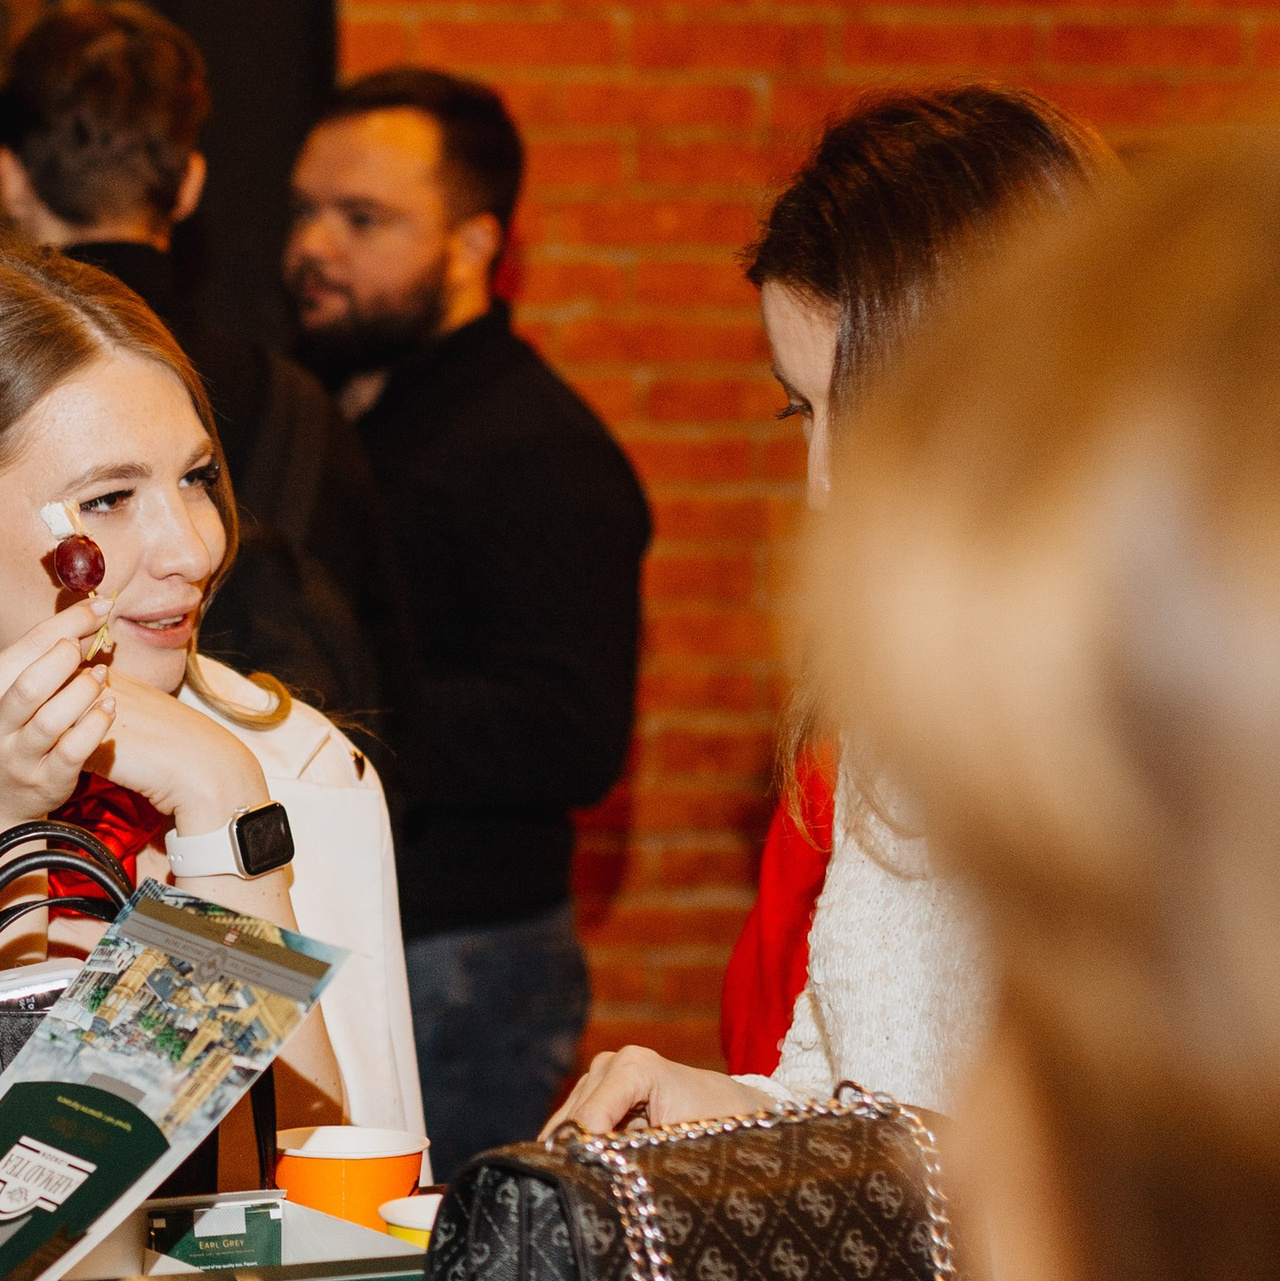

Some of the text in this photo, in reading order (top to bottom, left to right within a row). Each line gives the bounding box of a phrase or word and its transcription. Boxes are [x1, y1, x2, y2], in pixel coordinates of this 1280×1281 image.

[1, 1153, 79, 1197] AHMAD TEA
[198, 1238, 245, 1250] EARL GREY
